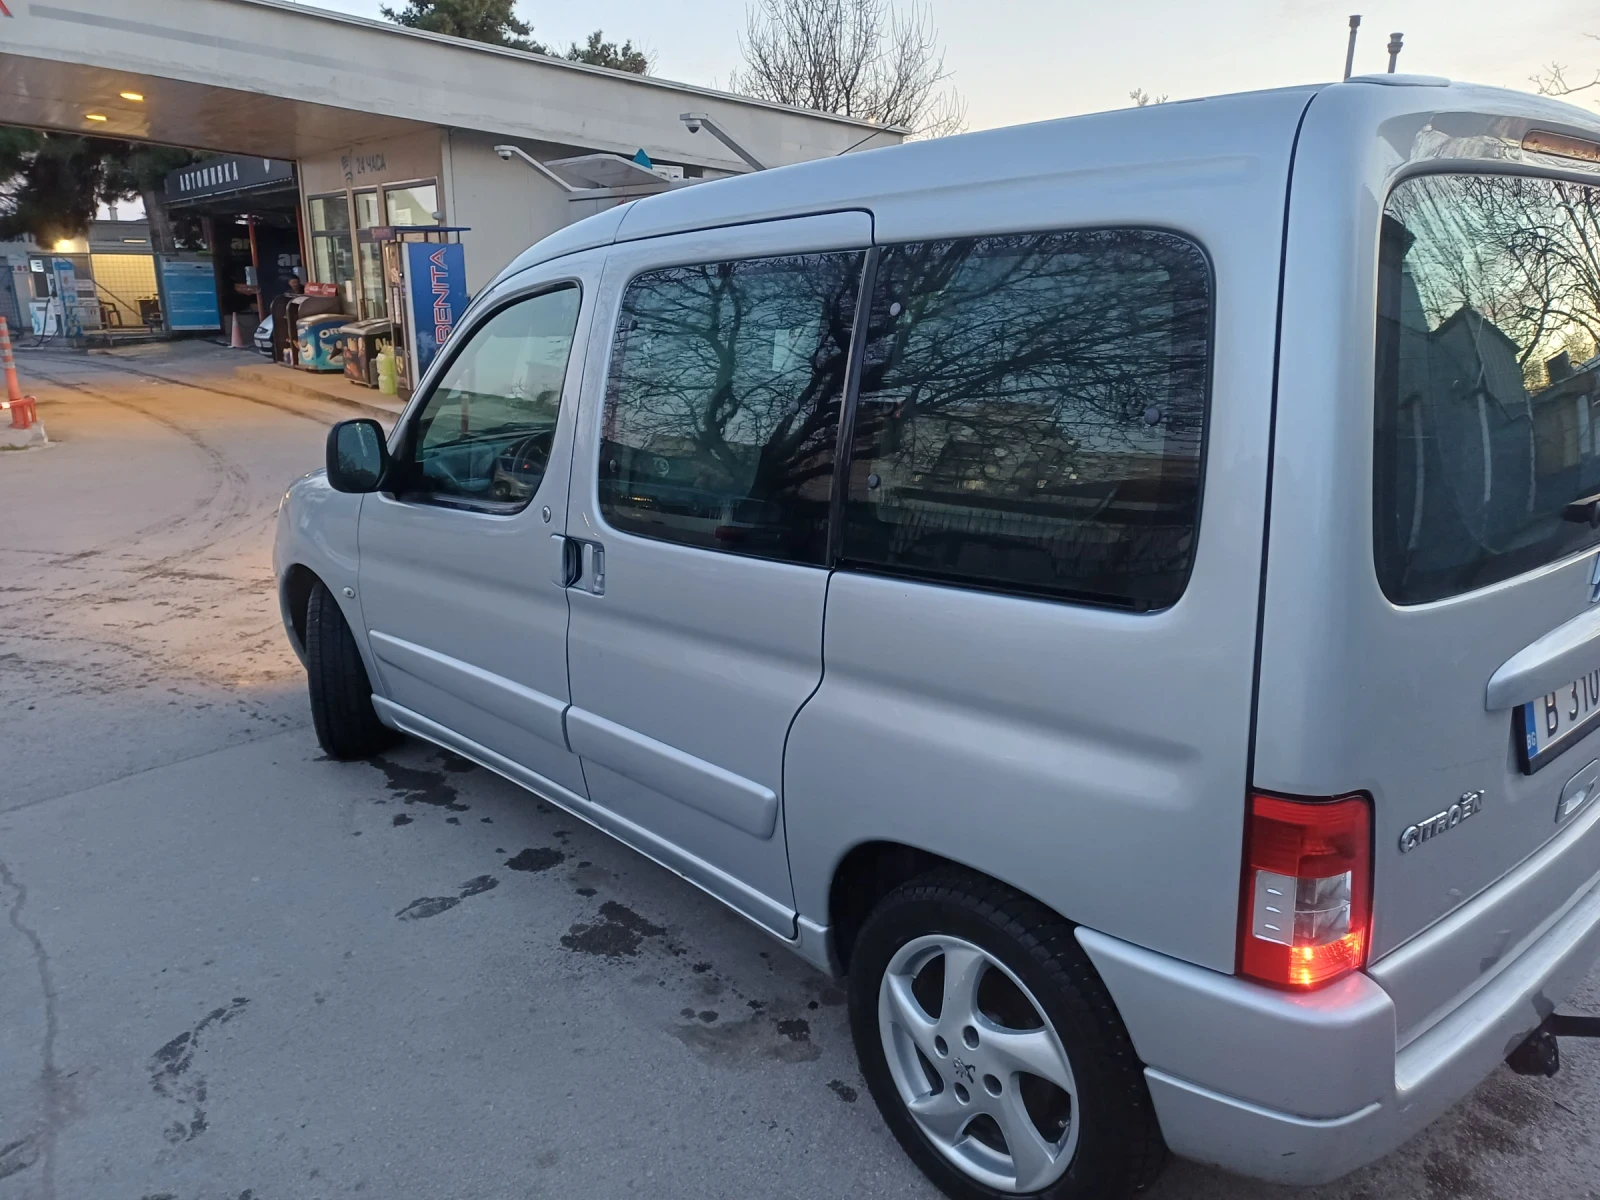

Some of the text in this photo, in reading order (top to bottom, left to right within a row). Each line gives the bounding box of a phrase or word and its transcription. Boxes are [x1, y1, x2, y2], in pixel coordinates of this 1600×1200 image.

[180, 161, 239, 192] АВТОМИВКА
[429, 247, 453, 345] BENITA
[1526, 731, 1536, 750] BG
[1399, 789, 1485, 853] CITROËN
